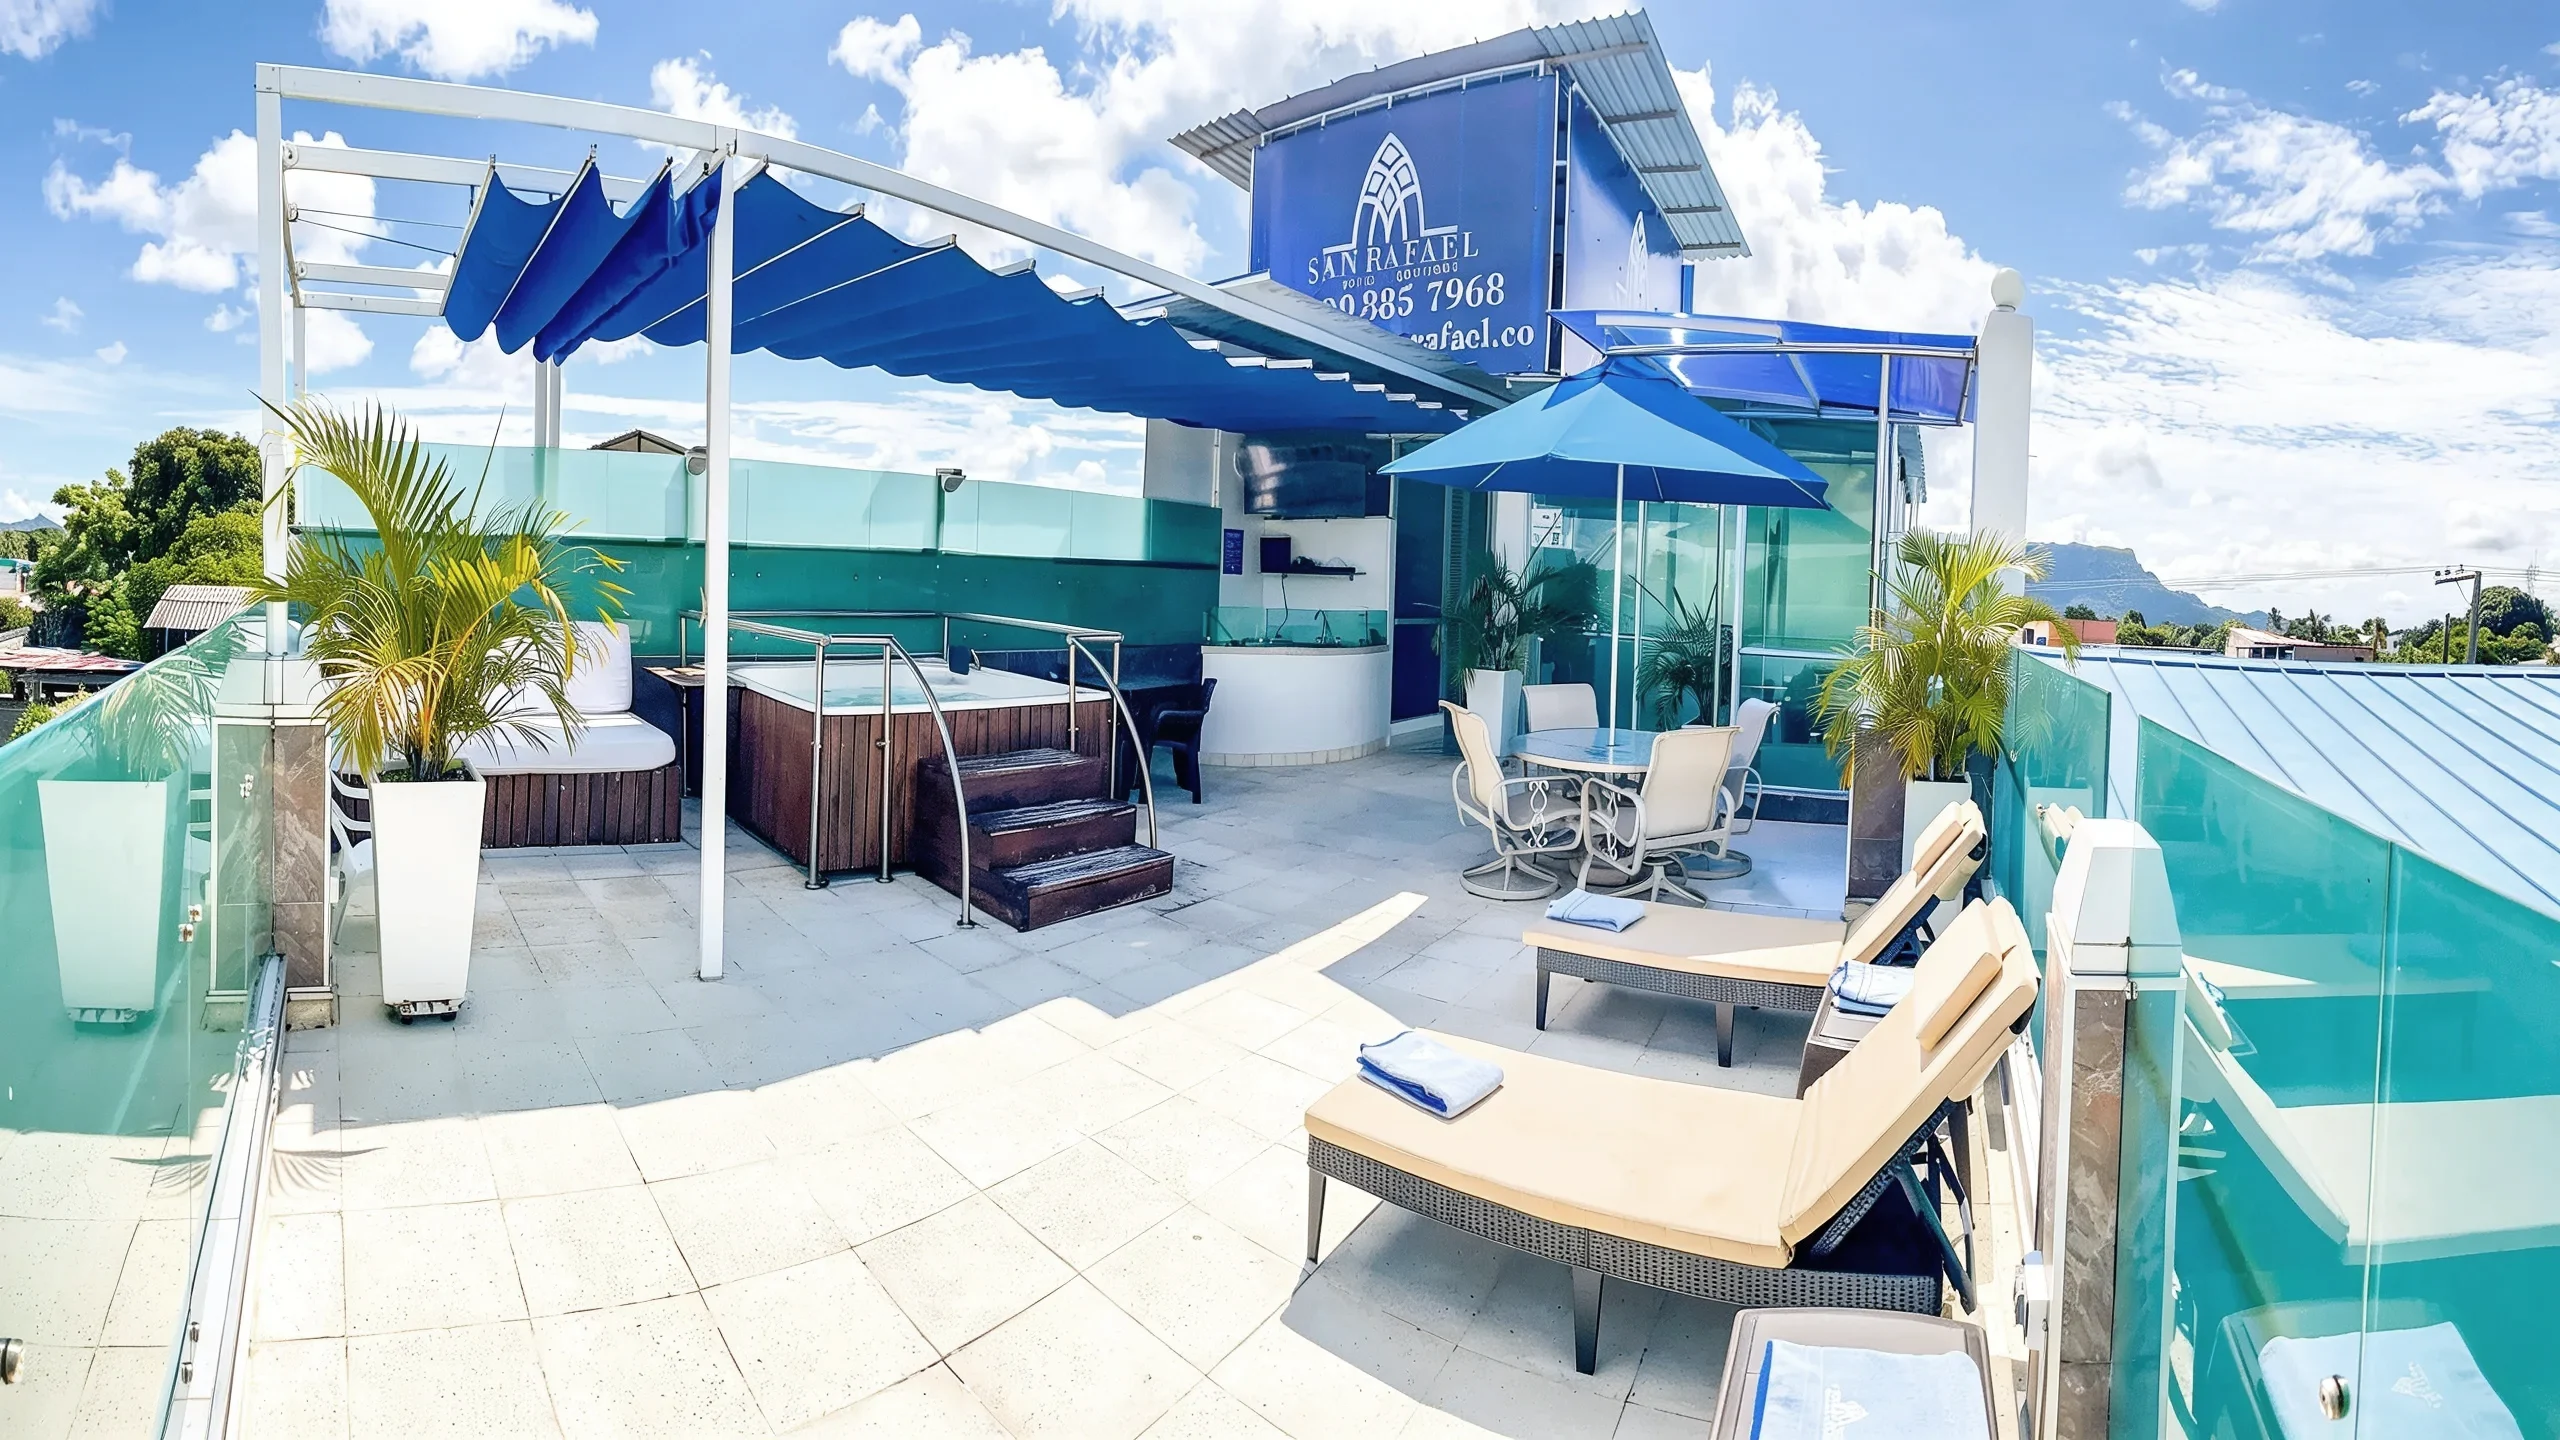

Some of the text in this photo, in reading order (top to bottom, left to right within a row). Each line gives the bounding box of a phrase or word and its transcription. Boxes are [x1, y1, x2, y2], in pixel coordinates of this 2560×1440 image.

[1308, 249, 1358, 285] SAN
[1365, 231, 1479, 273] RAFAEL
[1360, 283, 1414, 321] 885
[1427, 272, 1505, 312] 7968
